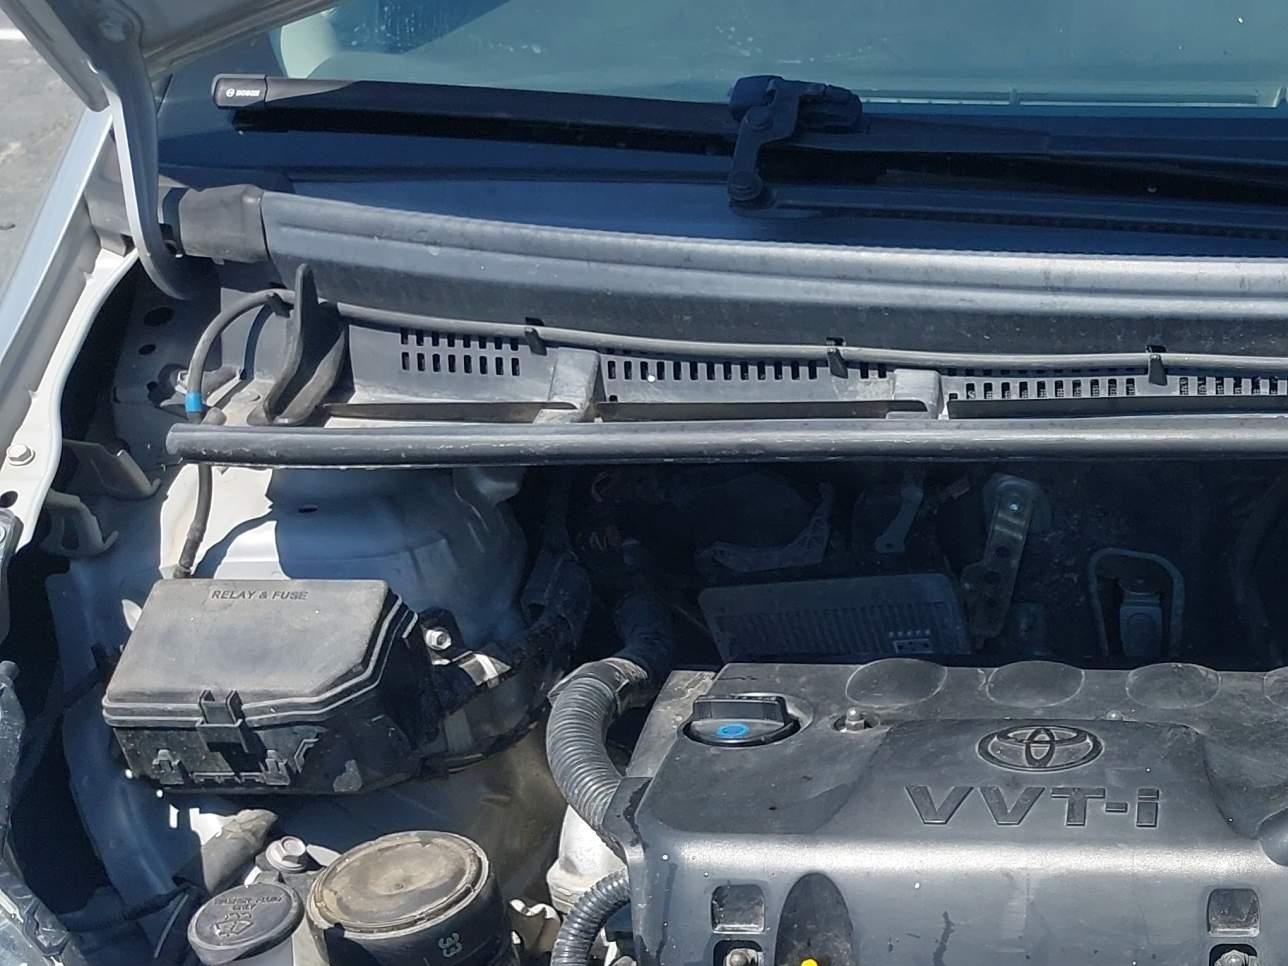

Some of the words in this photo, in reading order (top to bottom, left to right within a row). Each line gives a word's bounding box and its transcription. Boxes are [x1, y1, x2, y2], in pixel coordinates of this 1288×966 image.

[211, 590, 256, 600] RELAY
[272, 590, 309, 600] FUSE
[904, 786, 1160, 828] VVT-i
